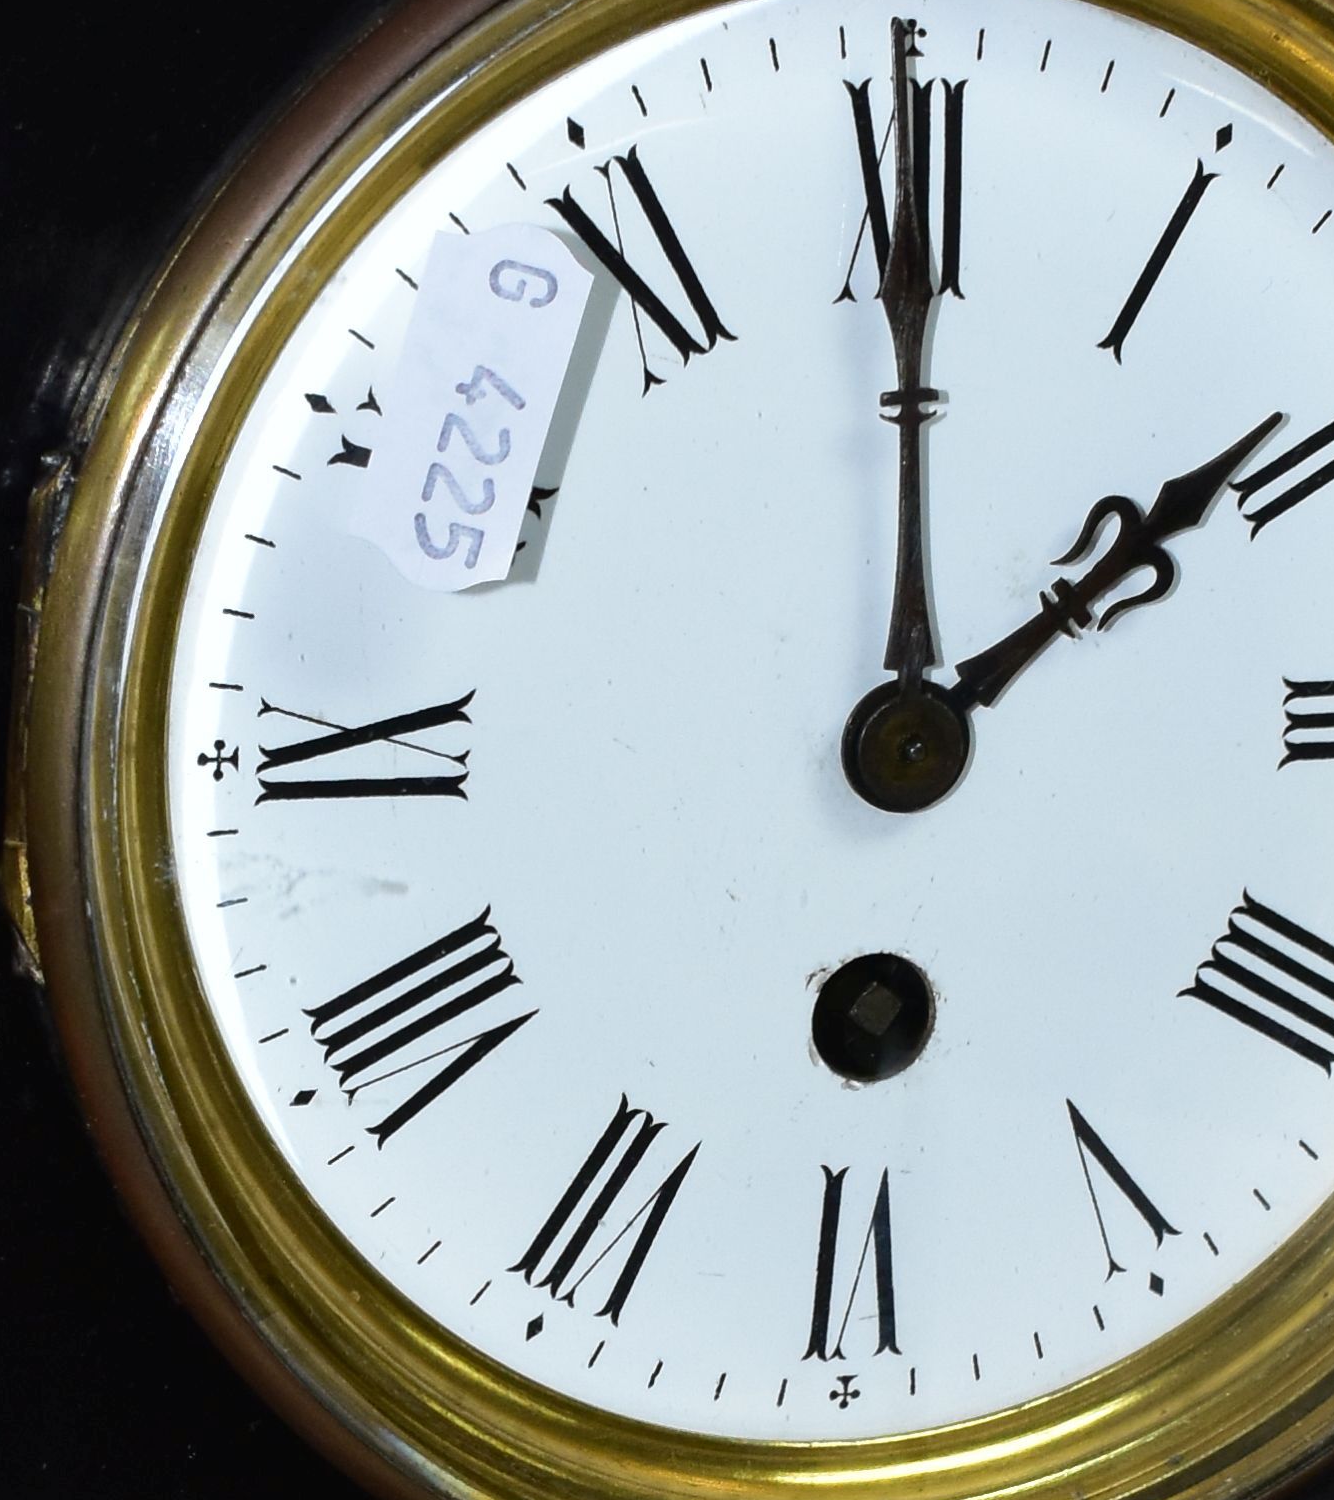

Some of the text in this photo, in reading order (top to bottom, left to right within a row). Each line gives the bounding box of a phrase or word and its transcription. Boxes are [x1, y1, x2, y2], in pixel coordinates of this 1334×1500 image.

[543, 143, 739, 398] XI
[832, 77, 968, 304] XII
[1096, 157, 1221, 366] I
[413, 258, 559, 570] G 4225
[254, 688, 477, 806] IX
[301, 903, 540, 1151] VIII
[506, 1091, 703, 1328] VII
[800, 1164, 903, 1362] VI
[1066, 1097, 1183, 1283] V
